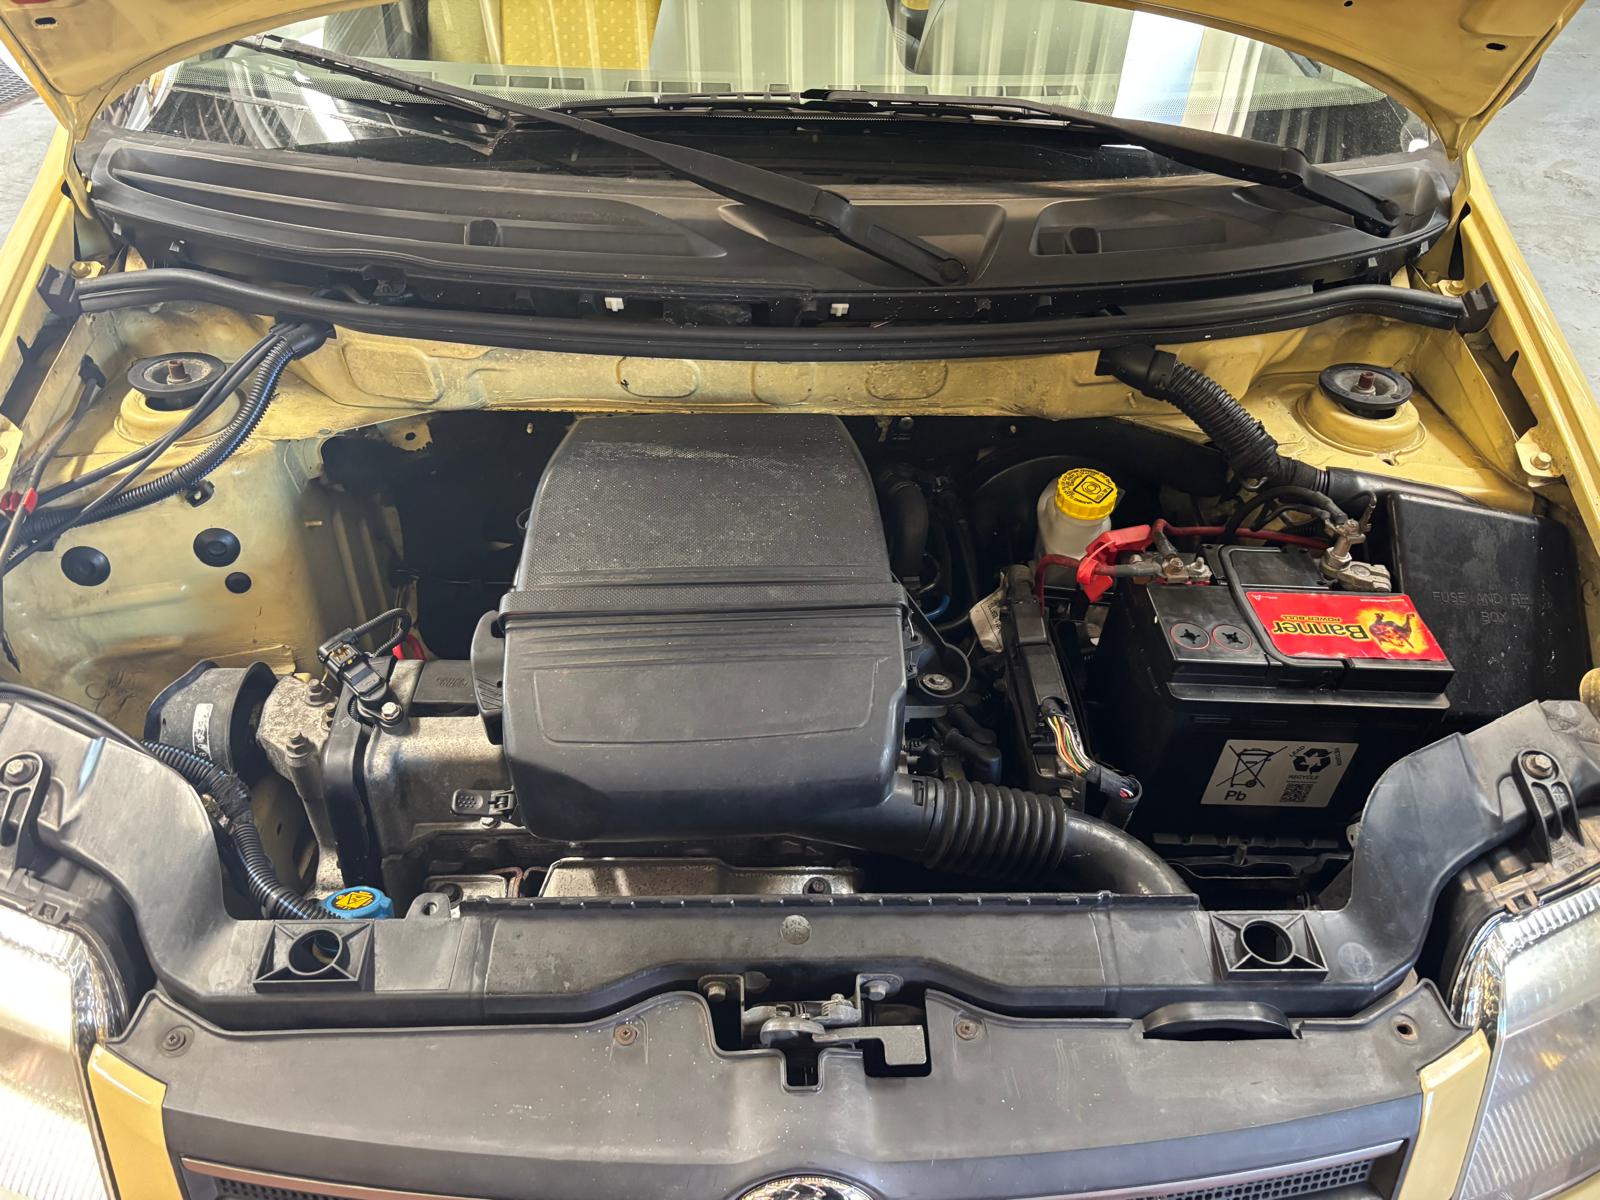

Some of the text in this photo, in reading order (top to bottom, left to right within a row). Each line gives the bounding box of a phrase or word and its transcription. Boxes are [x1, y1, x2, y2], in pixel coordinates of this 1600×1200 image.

[1432, 591, 1466, 604] FUSE
[1477, 592, 1503, 606] AND
[1480, 611, 1508, 625] BOX
[1273, 622, 1370, 640] Banner
[1224, 790, 1247, 800] Pb
